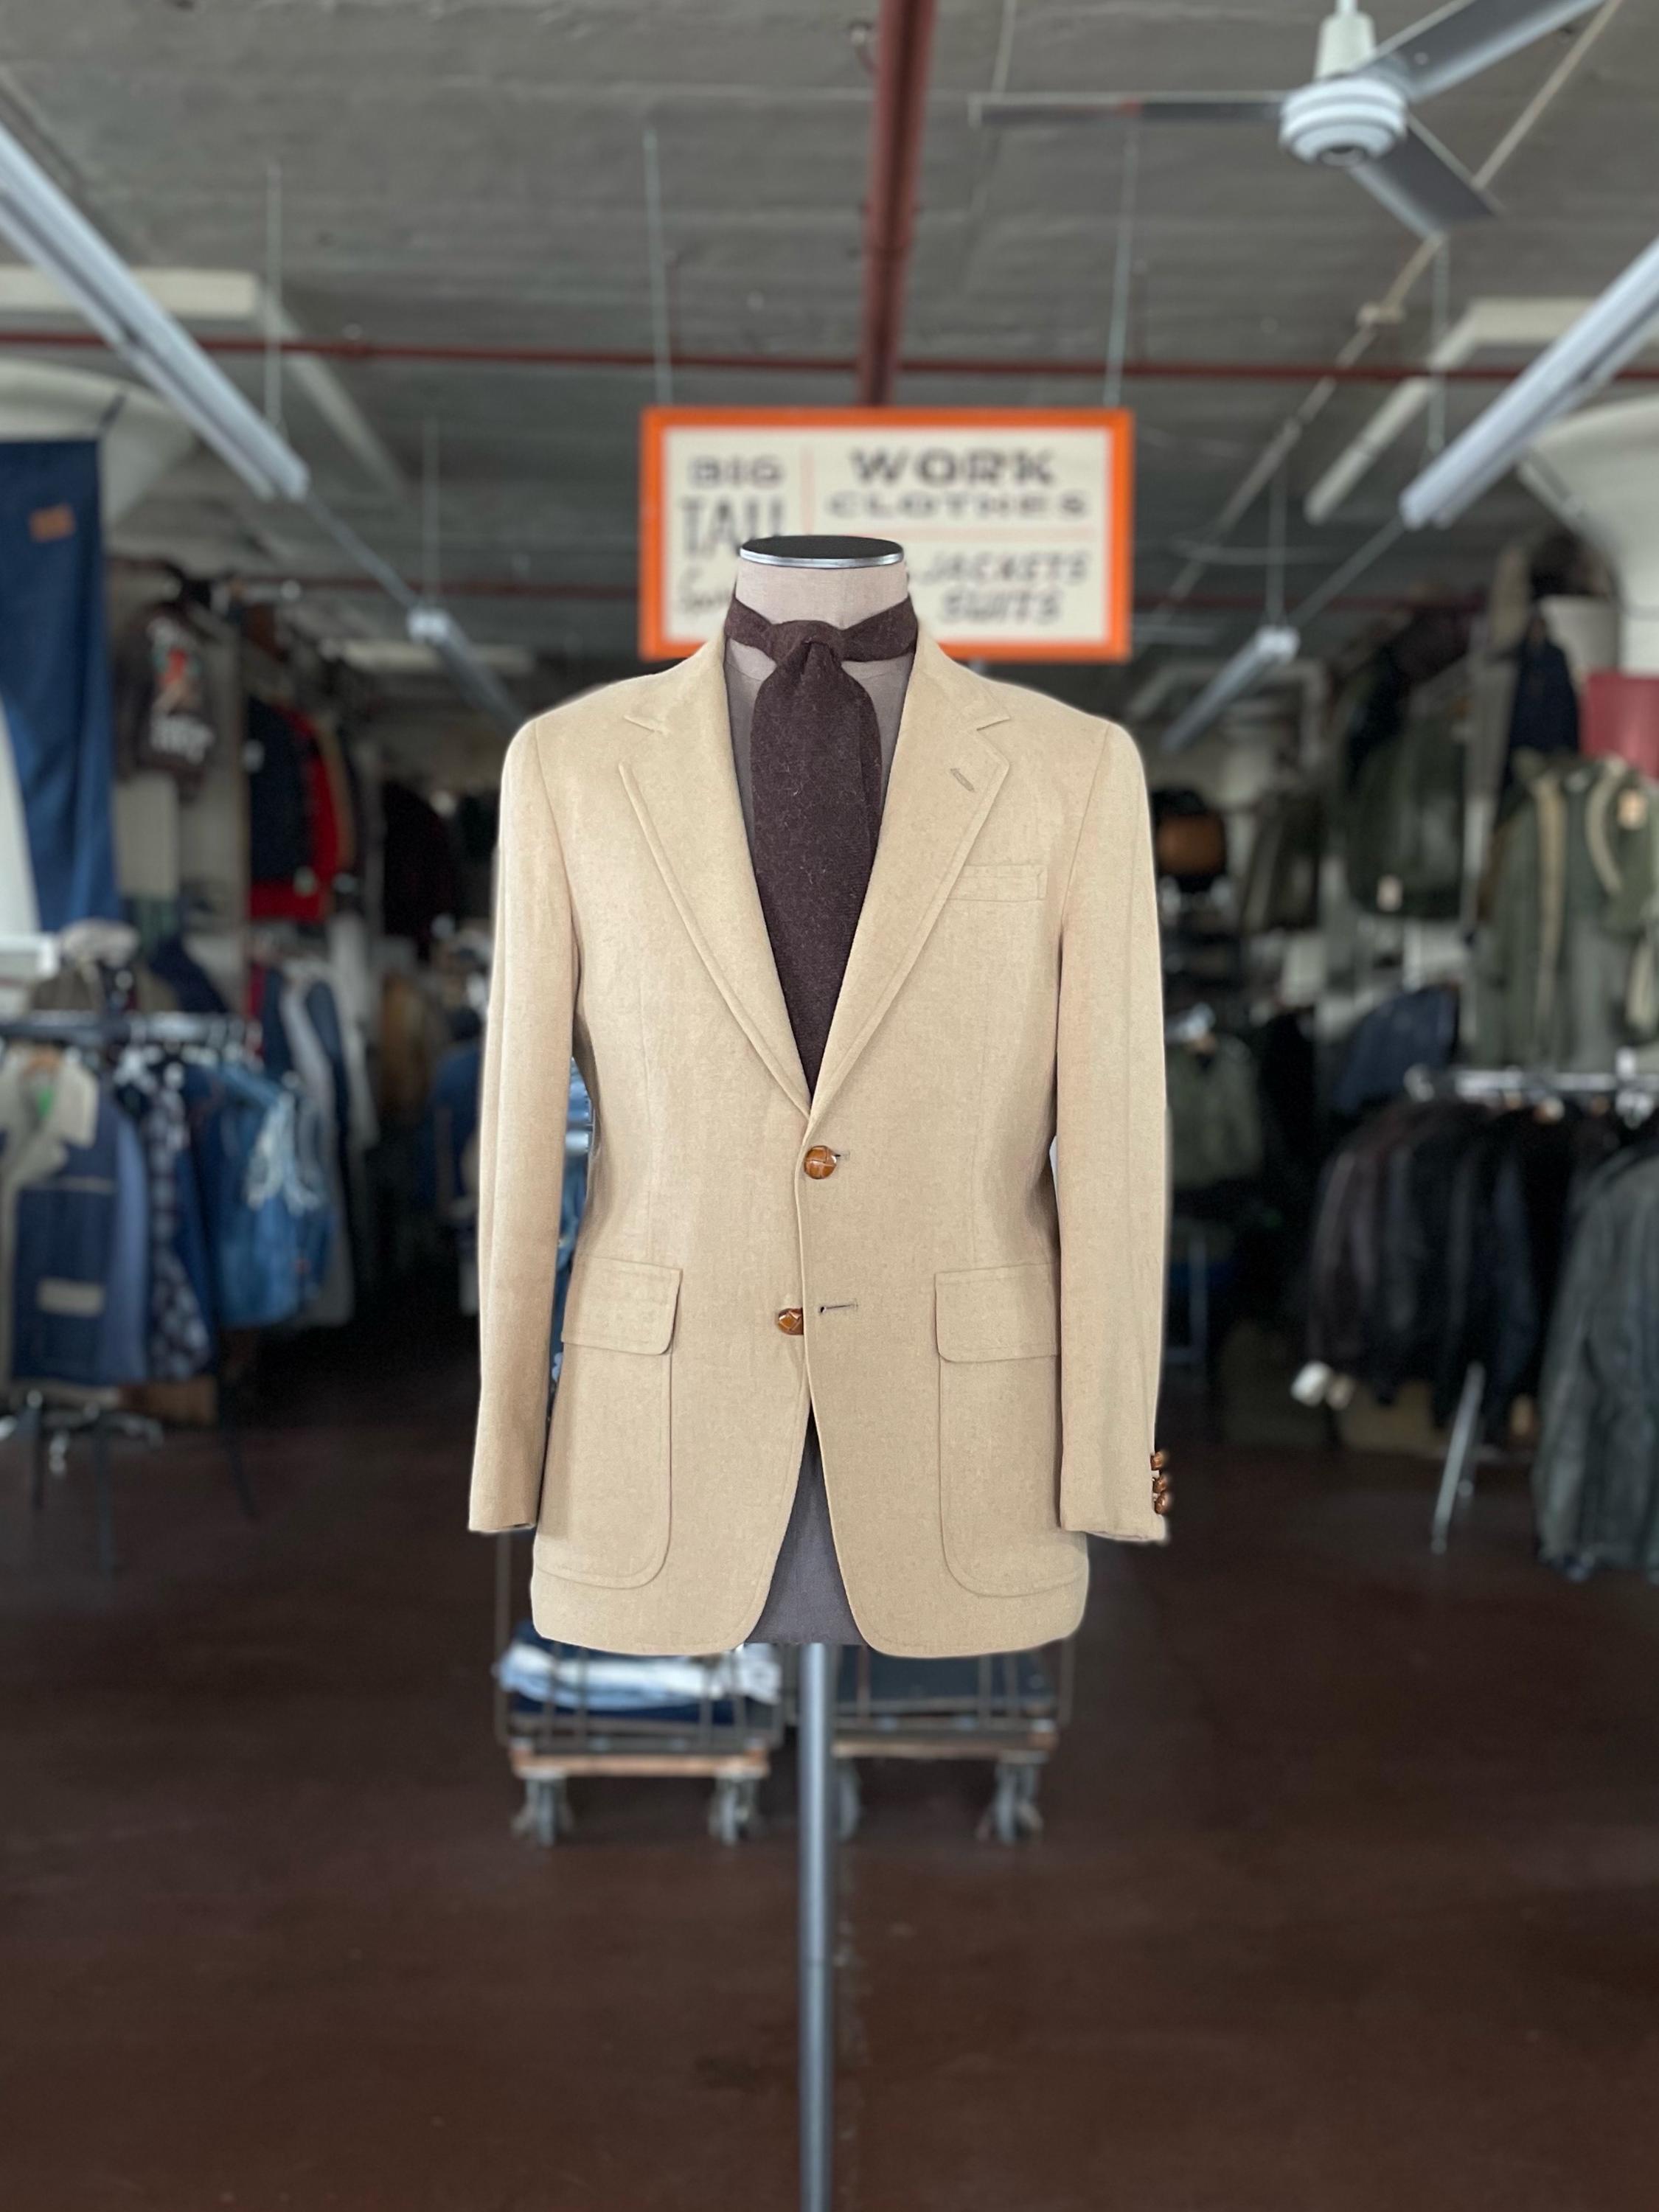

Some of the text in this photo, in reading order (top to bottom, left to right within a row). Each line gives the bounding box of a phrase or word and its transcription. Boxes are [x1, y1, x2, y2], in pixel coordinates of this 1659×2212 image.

[691, 456, 783, 487] BIG
[850, 448, 1055, 484] WORK
[827, 490, 1087, 518] CLOTHES
[920, 551, 1090, 584] JACKETS
[940, 586, 1062, 623] SUITS
